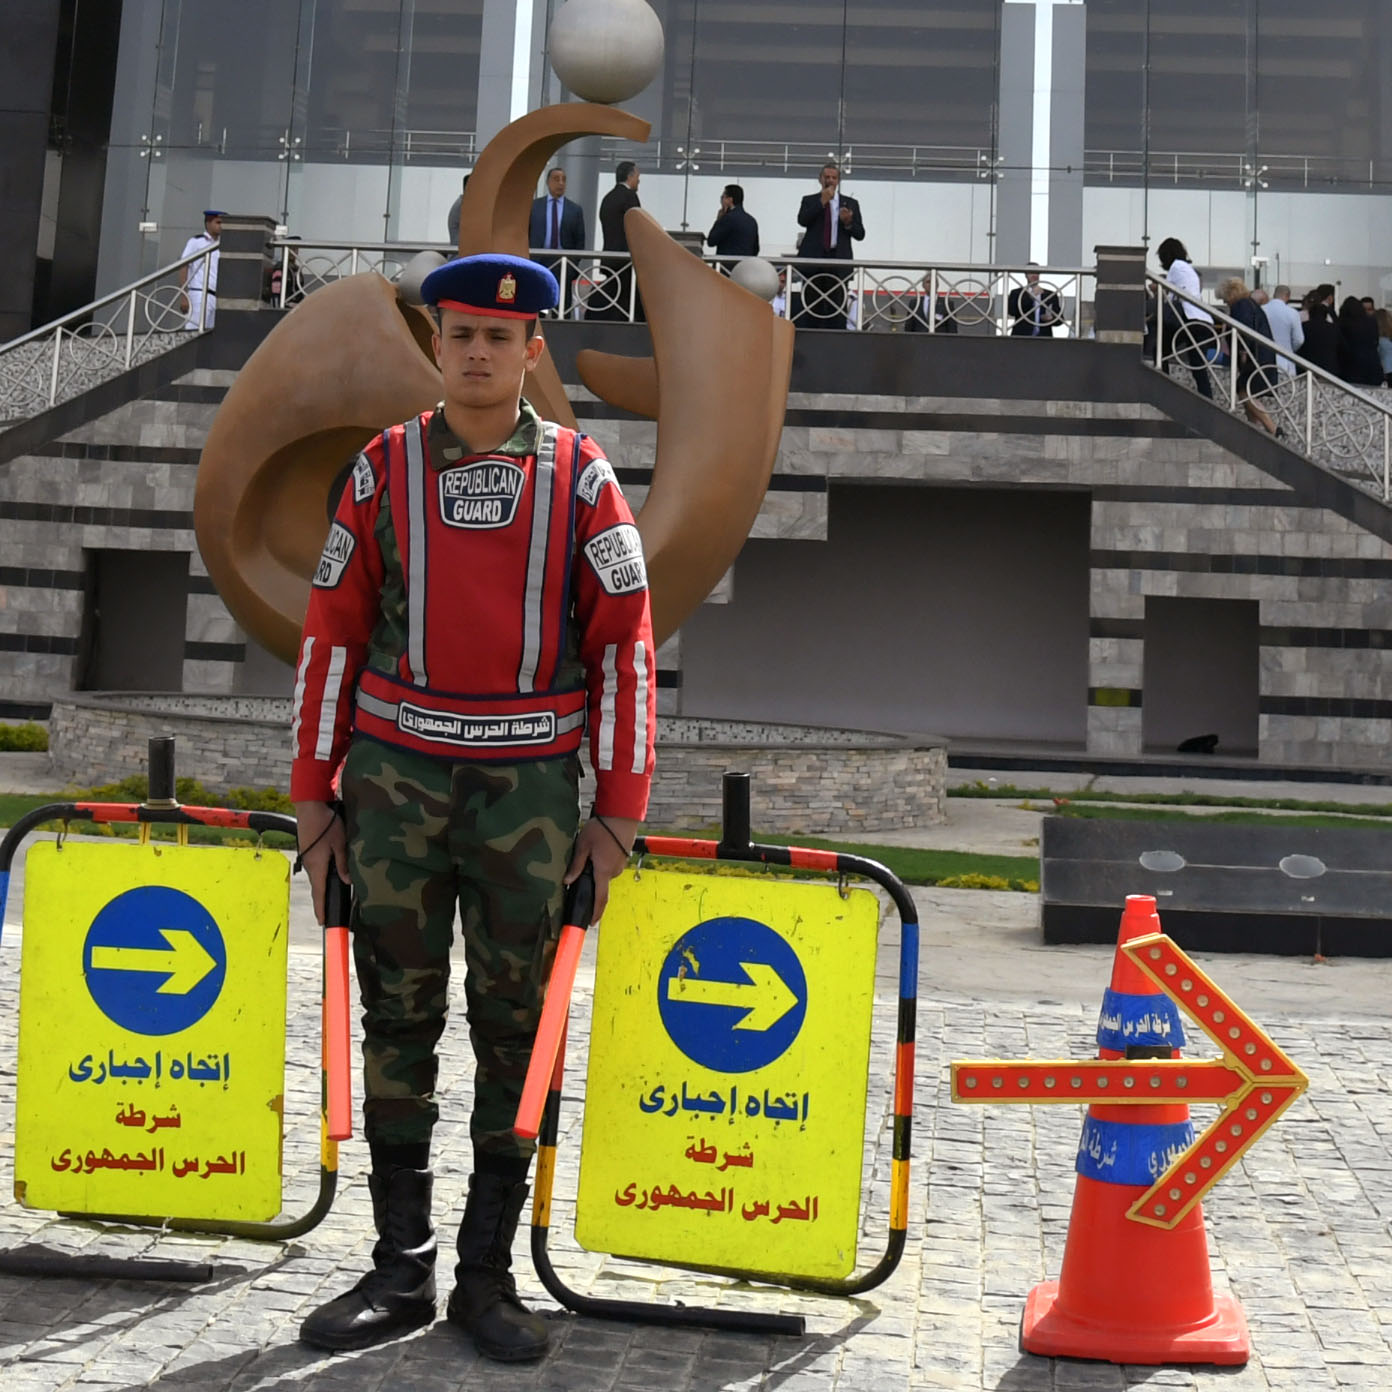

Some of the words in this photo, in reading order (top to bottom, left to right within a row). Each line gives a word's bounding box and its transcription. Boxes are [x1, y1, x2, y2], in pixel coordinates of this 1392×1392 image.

[444, 467, 518, 495] REPUBLICAN
[453, 500, 502, 522] GUARD
[611, 561, 645, 590] GUAR
[464, 722, 508, 739] الحرس
[511, 716, 550, 737] شرطة
[1151, 1012, 1171, 1038] شرطة
[68, 1049, 162, 1090] إجبارى
[169, 1051, 230, 1091] إتجاه
[115, 1101, 182, 1134] شرطة
[639, 1080, 737, 1126] إجبارى
[745, 1088, 809, 1132] إتجاه
[172, 1150, 246, 1180] الحرس
[684, 1135, 754, 1172] شرطة
[741, 1195, 819, 1225] الحرس
